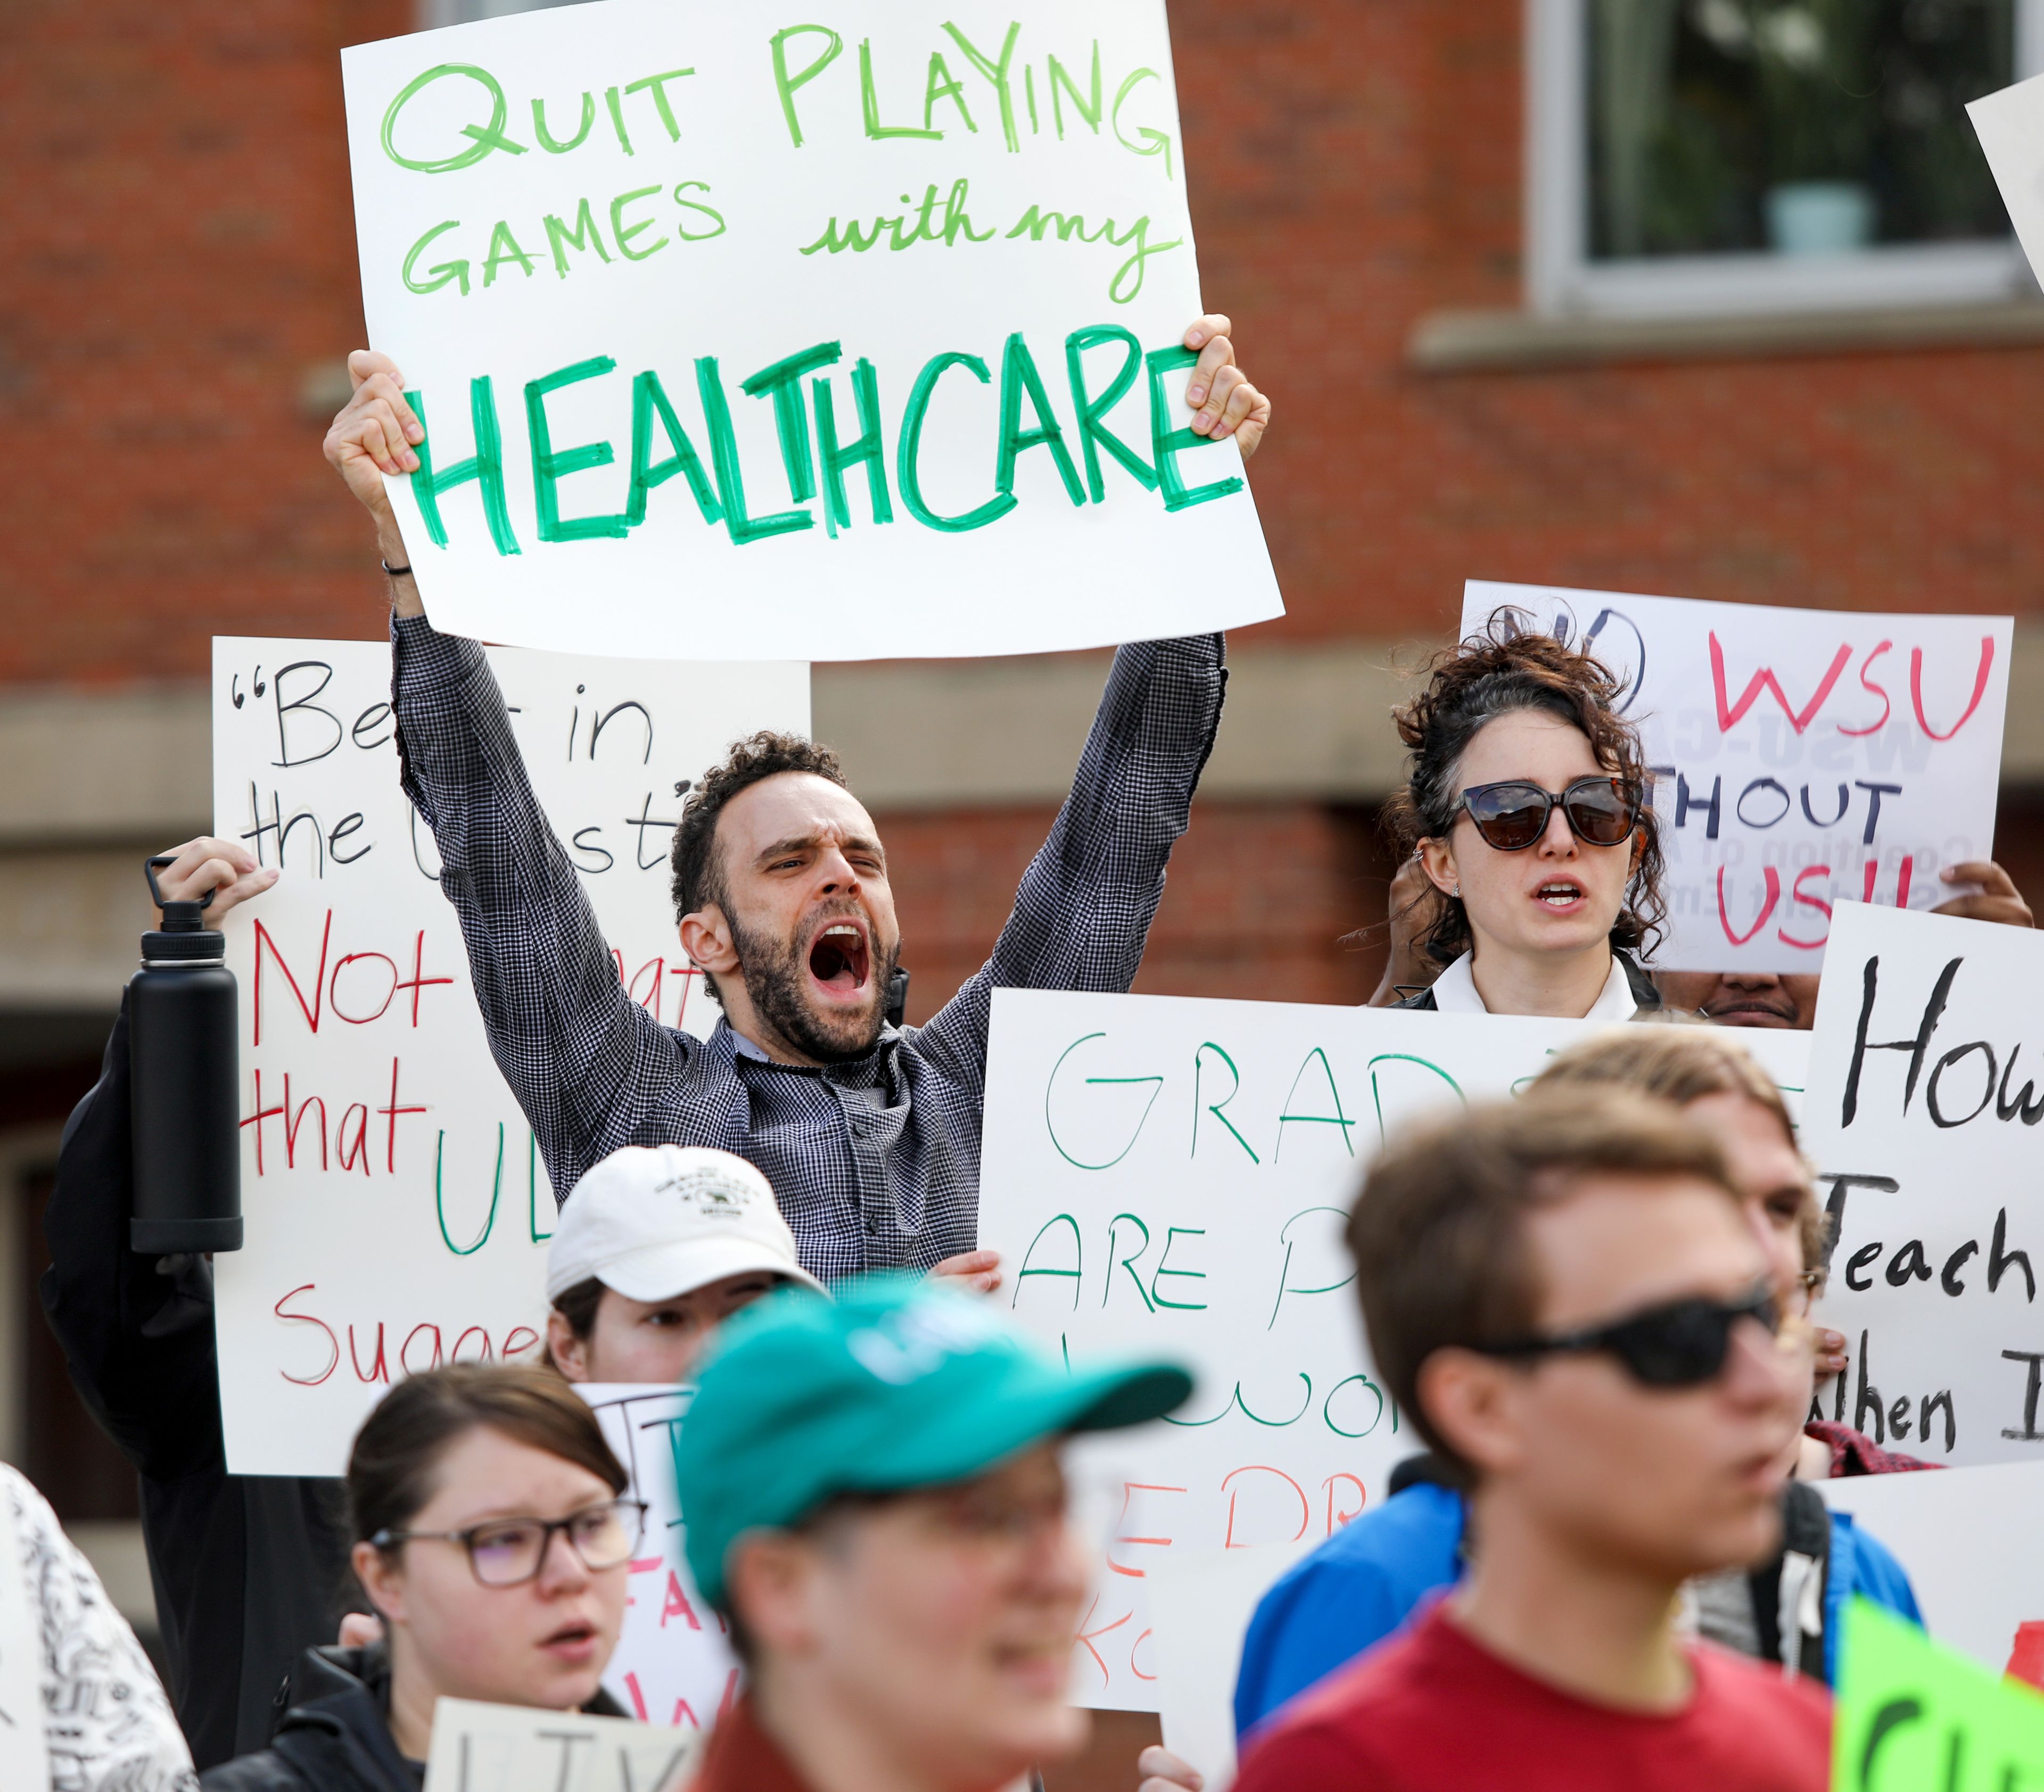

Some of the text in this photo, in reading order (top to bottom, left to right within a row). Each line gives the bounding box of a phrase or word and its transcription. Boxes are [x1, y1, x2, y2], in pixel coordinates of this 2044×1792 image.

[381, 21, 1173, 181] QUIT PLAYING
[402, 178, 1183, 303] GAMES with my
[403, 323, 1244, 556] HEALTHCARE
[569, 684, 652, 765] in
[1708, 629, 1994, 741] WSU
[241, 780, 377, 880] the
[254, 909, 453, 1046] Not
[1842, 955, 2044, 1128] How
[239, 1056, 426, 1177] that
[1046, 1031, 1468, 1170] GRAD
[1013, 1213, 1207, 1313] ARE
[1817, 1172, 2035, 1303] Teach
